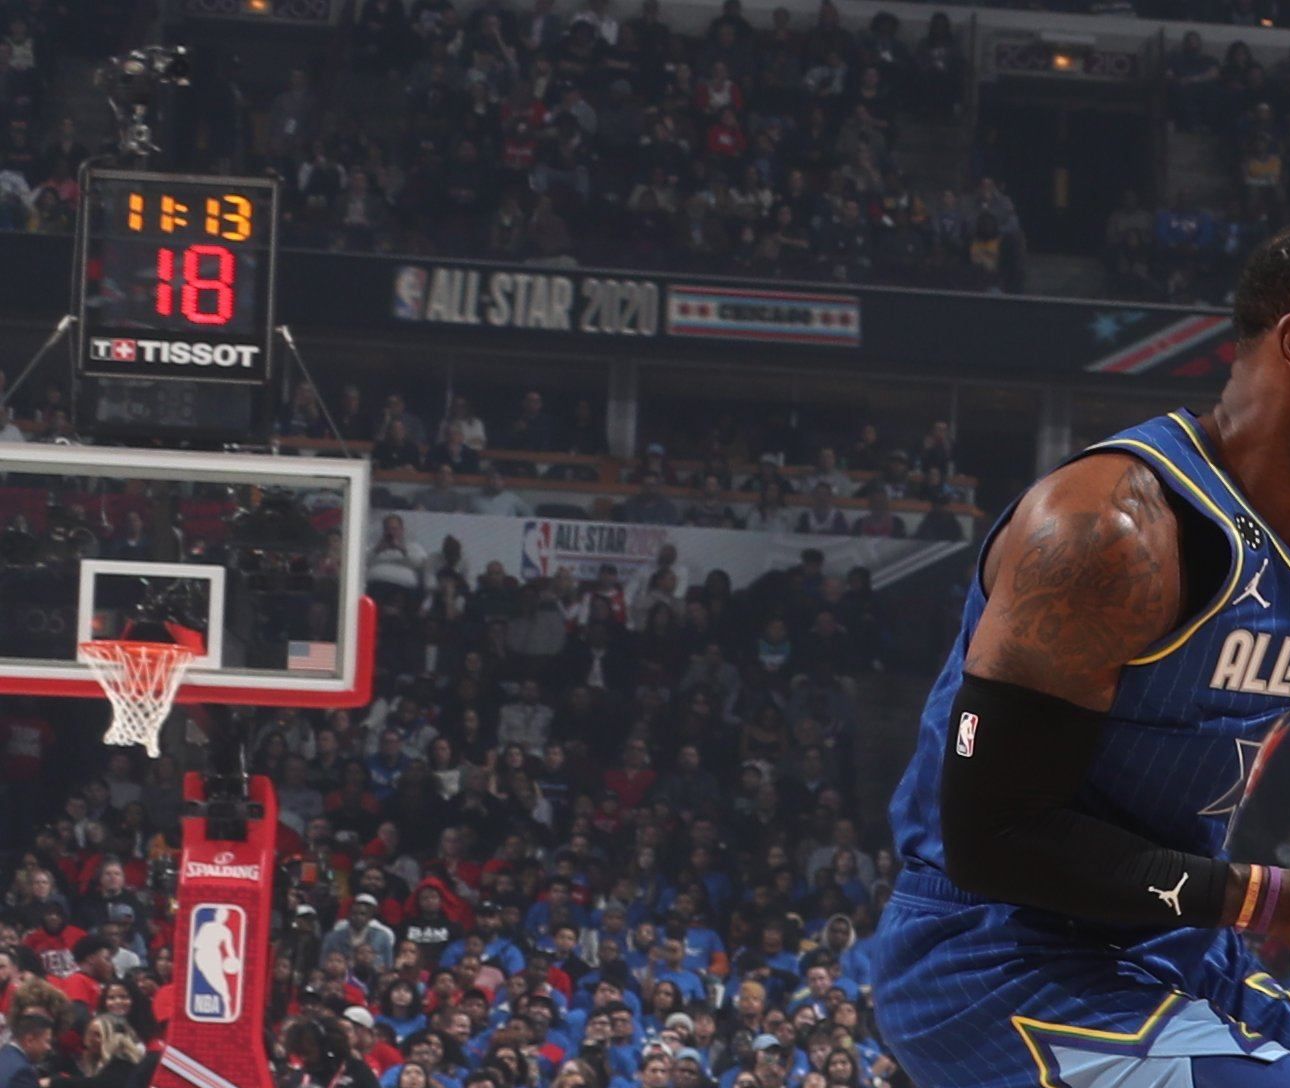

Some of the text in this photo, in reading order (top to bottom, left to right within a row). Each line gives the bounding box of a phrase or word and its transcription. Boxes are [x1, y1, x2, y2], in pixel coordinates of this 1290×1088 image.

[156, 244, 235, 325] 18
[580, 279, 659, 336] 2020
[137, 340, 260, 368] TISSOT
[185, 860, 261, 881] SPALDING
[193, 993, 221, 1014] NBA
